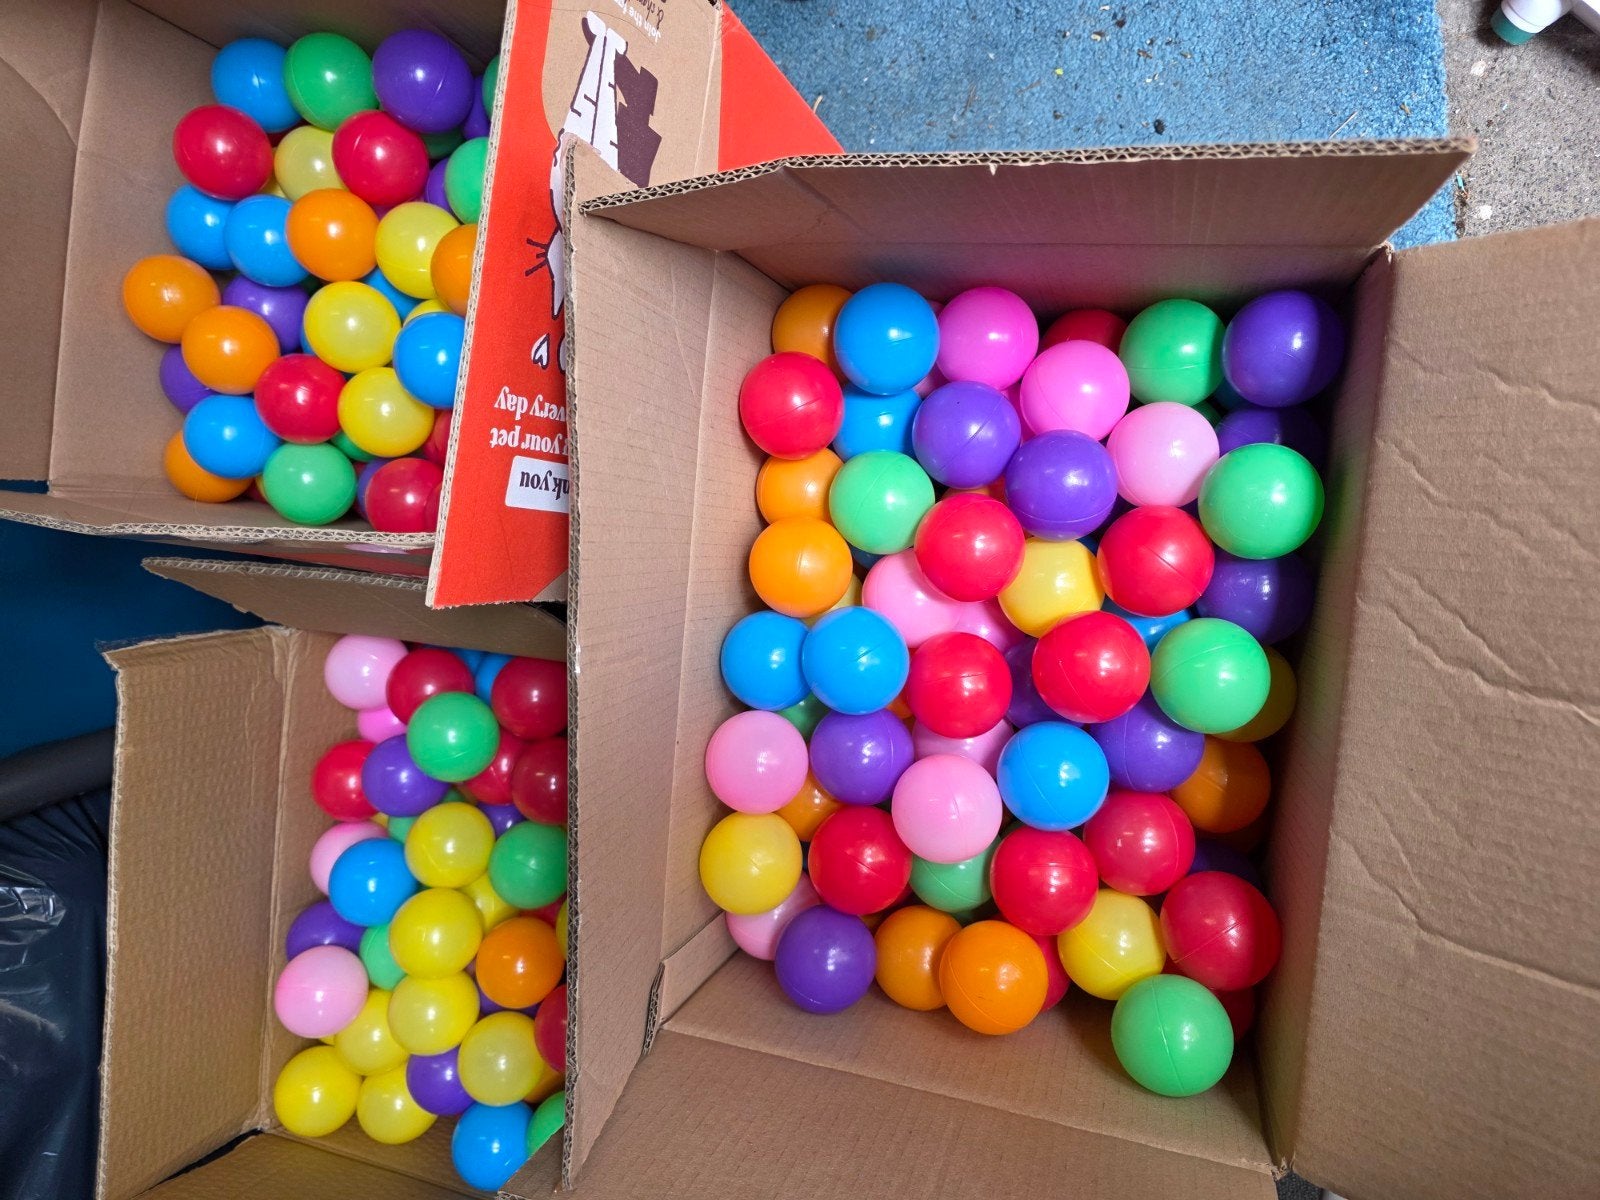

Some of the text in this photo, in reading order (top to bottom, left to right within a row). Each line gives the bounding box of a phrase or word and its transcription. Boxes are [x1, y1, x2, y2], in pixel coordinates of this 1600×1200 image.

[494, 386, 566, 422] very day
[489, 425, 521, 448] pet
[521, 433, 563, 454] your
[519, 470, 553, 491] you
